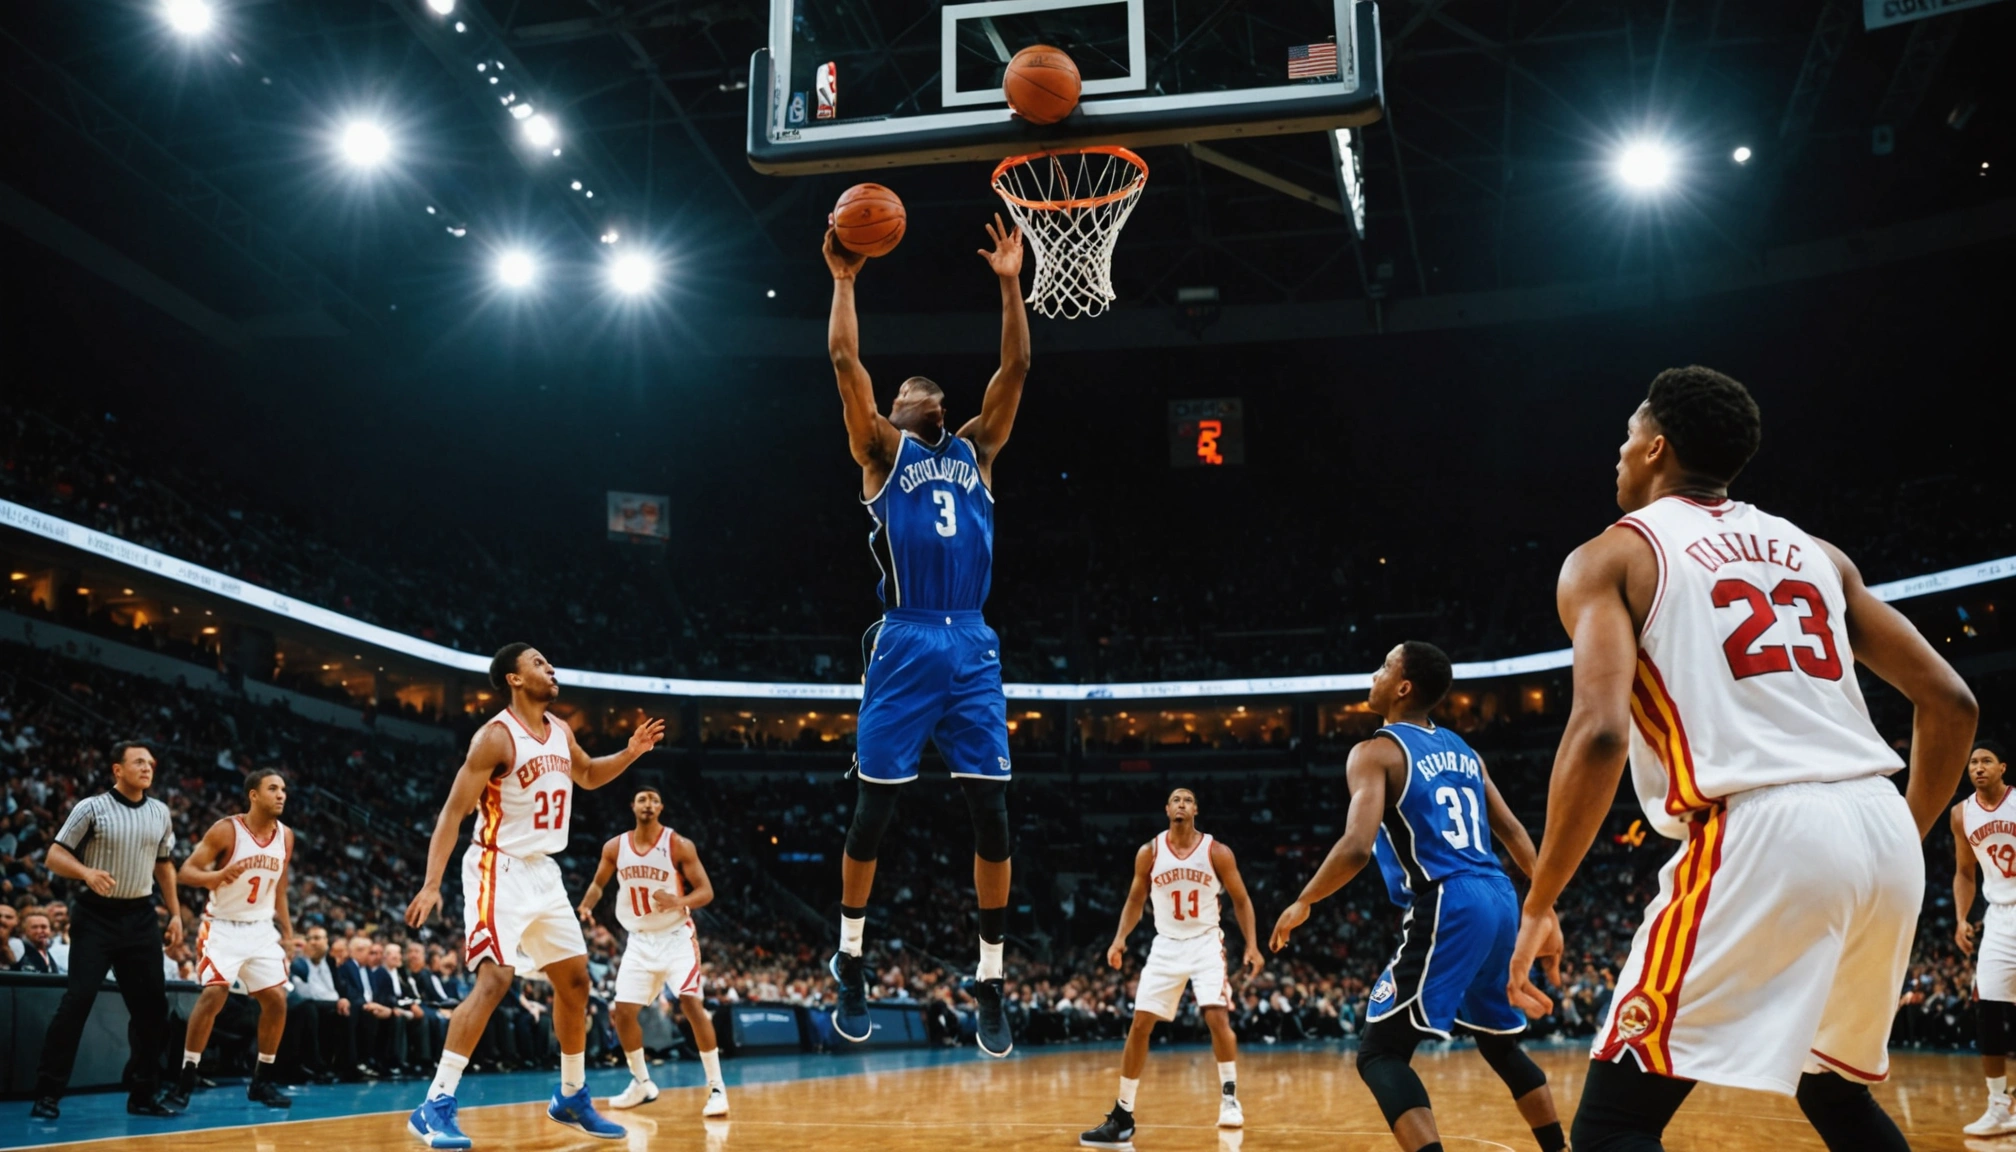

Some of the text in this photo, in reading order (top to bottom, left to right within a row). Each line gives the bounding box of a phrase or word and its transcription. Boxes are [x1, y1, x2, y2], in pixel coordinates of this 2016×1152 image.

[933, 489, 957, 537] 3
[1710, 578, 1844, 682] 23
[1435, 786, 1488, 855] 31
